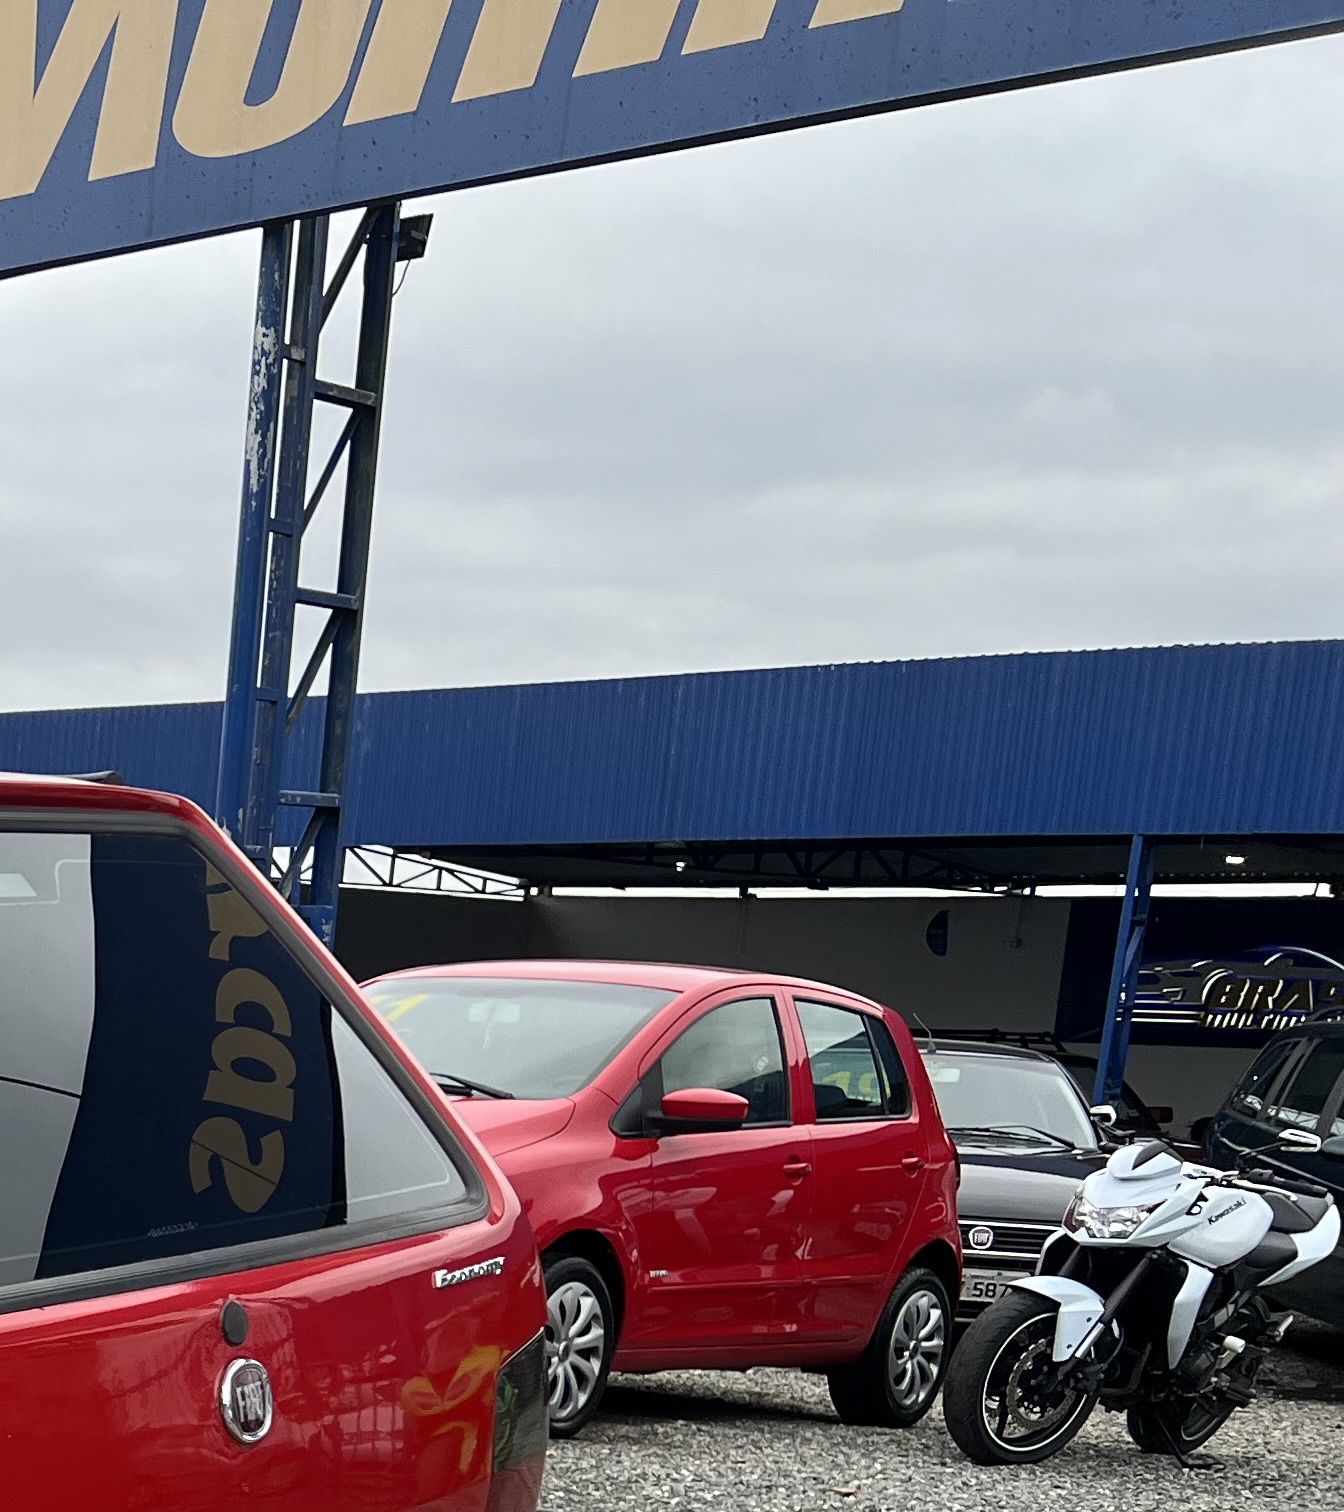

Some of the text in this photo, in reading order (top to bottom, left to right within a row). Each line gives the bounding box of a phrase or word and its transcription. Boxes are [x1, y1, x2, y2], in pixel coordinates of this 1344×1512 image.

[1207, 1196, 1247, 1225] Kawasaki
[434, 1256, 506, 1288] Economy
[972, 1281, 1012, 1299] 587
